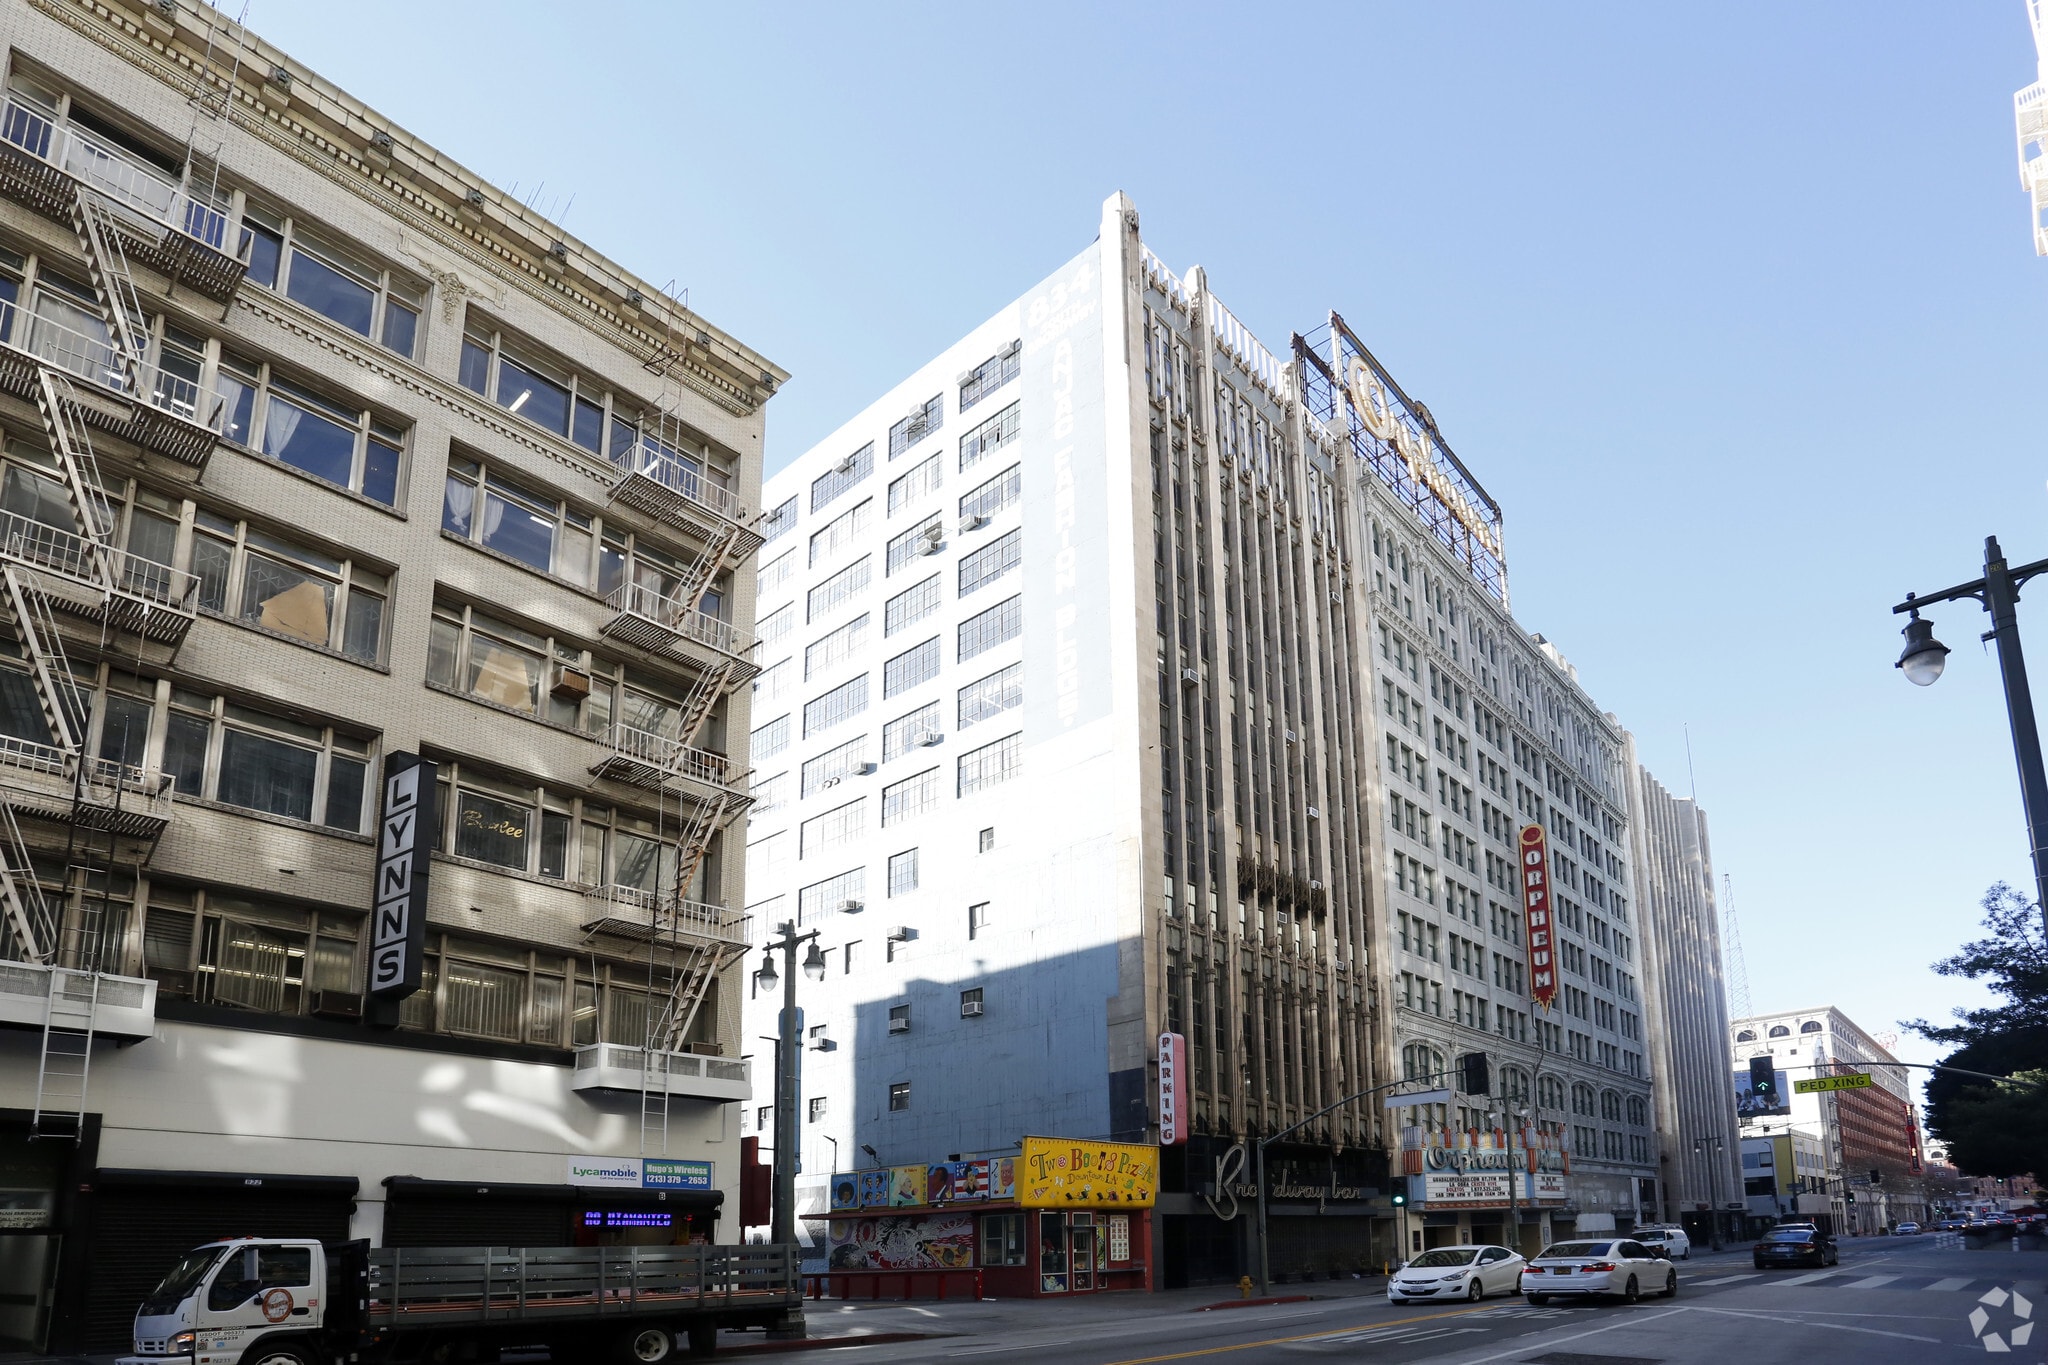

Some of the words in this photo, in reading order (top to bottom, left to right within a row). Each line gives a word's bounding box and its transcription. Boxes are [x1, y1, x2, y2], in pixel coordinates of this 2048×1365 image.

[1027, 262, 1096, 328] 834
[1052, 337, 1074, 440] ANJAC
[1053, 443, 1076, 597] FASHION
[377, 778, 412, 983] LYNNS
[1525, 850, 1551, 988] ORPHEUM
[1161, 1037, 1173, 1140] PARKING
[1800, 1081, 1827, 1091] PED
[1833, 1076, 1865, 1087] XING
[573, 1166, 637, 1178] Lycamobile
[646, 1164, 673, 1174] Hugo's
[673, 1165, 708, 1175] Wireless
[646, 1175, 666, 1184] (213)
[688, 1176, 708, 1185] 2653
[1427, 1146, 1527, 1176] Orpheum
